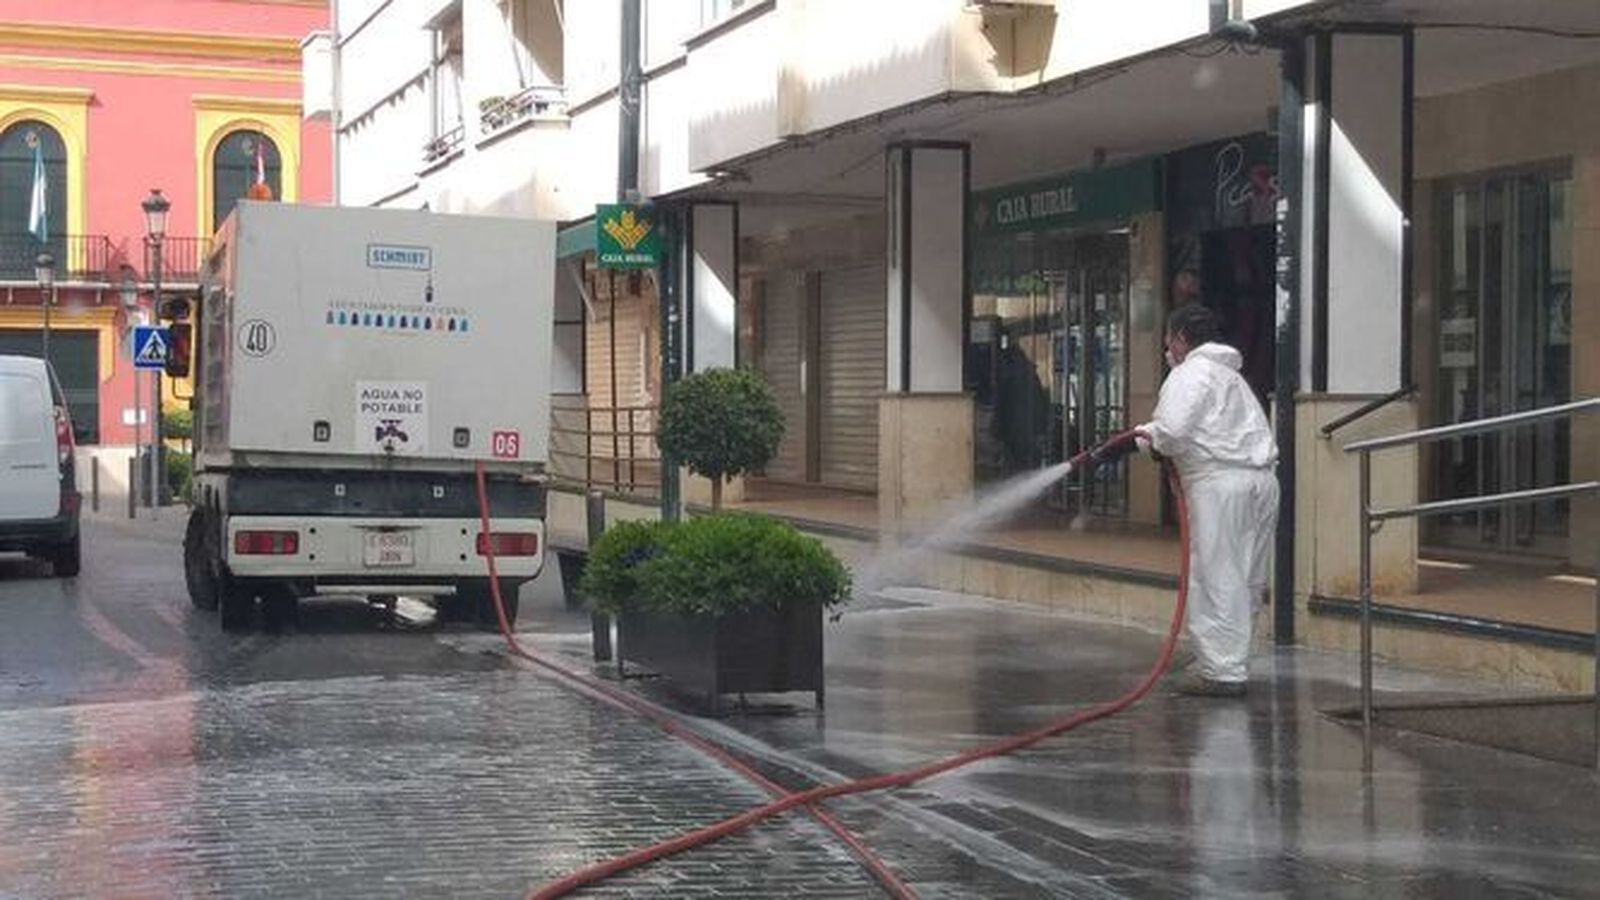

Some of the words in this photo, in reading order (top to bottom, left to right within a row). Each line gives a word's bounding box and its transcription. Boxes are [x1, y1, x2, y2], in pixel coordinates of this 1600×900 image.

[246, 323, 268, 352] 40
[361, 389, 400, 400] AGUA
[403, 389, 423, 401] NO
[361, 403, 423, 413] POTABLE
